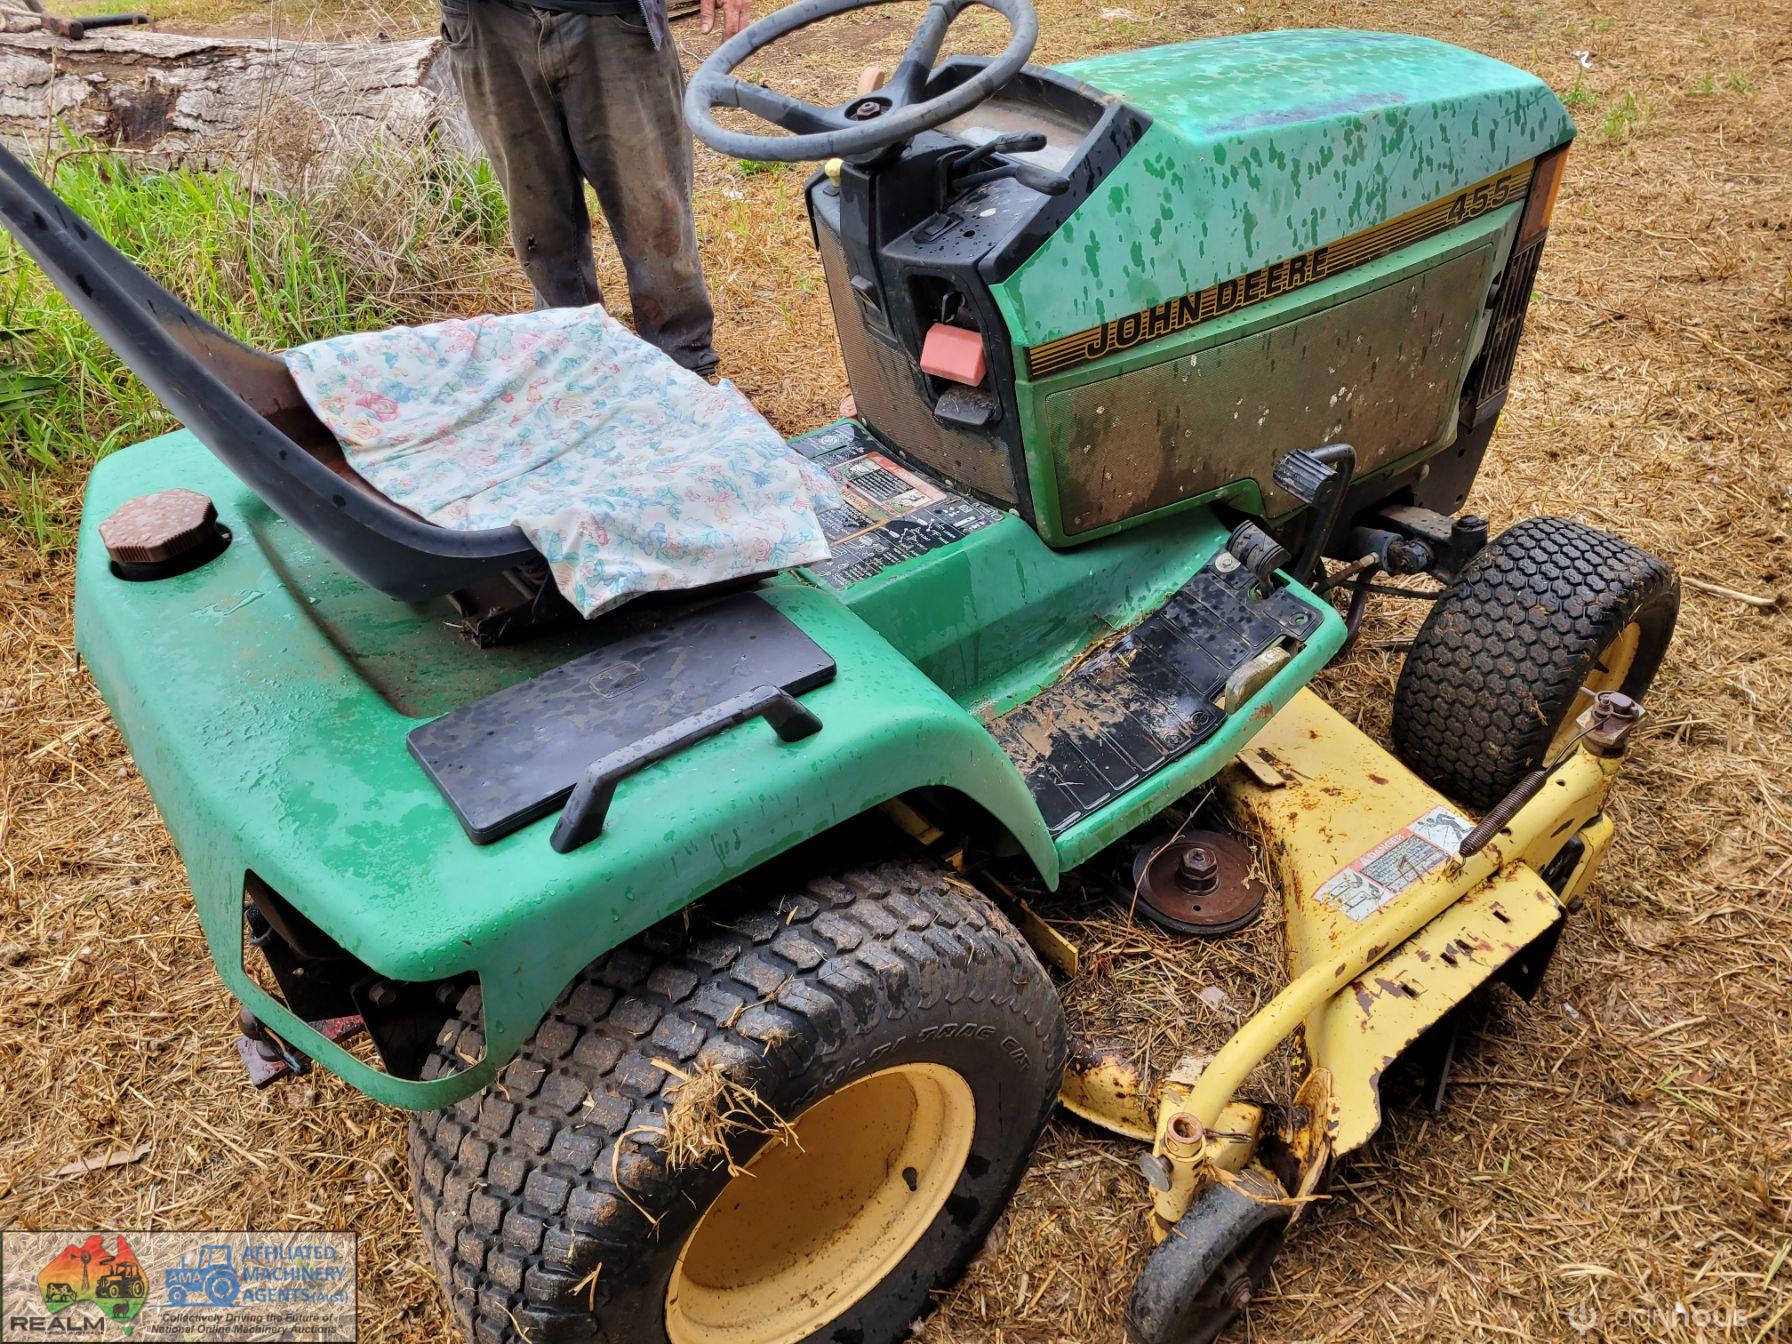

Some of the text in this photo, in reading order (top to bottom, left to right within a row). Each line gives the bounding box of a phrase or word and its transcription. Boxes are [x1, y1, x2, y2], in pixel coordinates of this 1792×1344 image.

[1446, 174, 1513, 225] 455
[1084, 246, 1329, 359] JOHN DEERE
